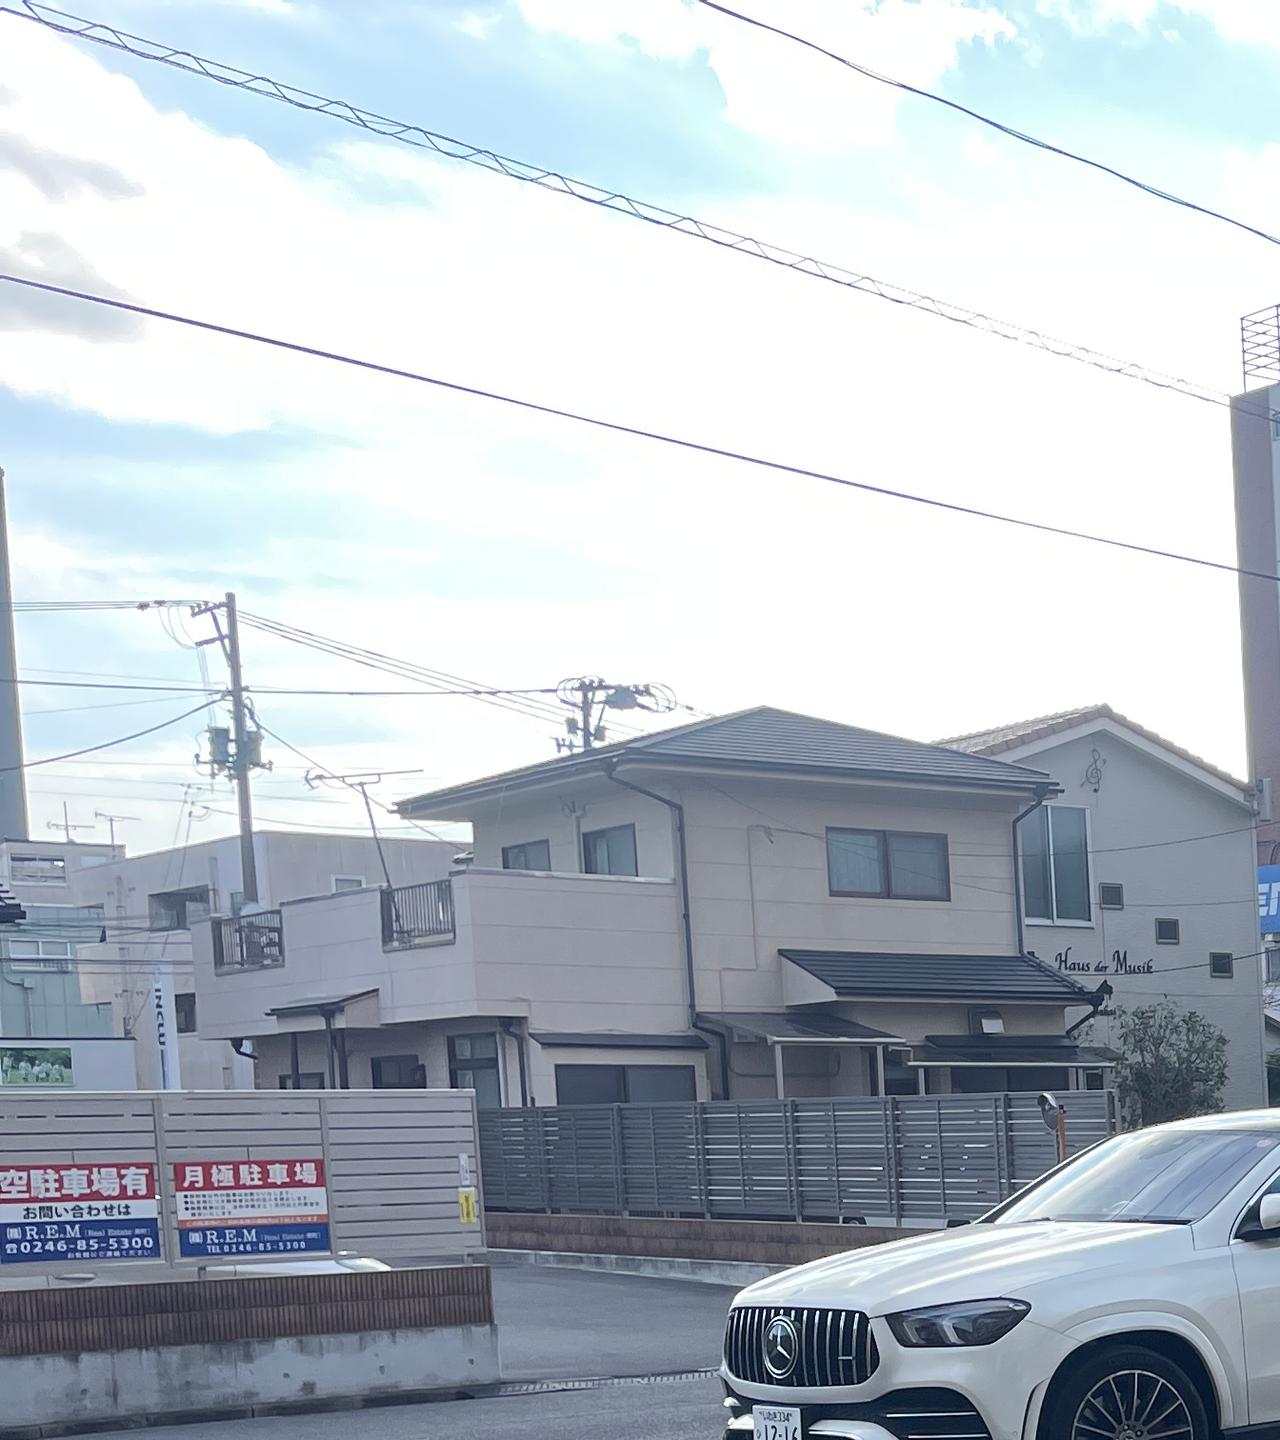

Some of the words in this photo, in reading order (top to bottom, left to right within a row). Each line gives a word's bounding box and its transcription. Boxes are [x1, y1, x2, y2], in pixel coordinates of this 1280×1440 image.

[1055, 947, 1091, 972] Haus
[1094, 961, 1109, 972] der
[1112, 950, 1153, 974] Musik
[0, 1166, 149, 1199] 空駐車場有
[183, 1162, 317, 1188] 月極駐車場
[23, 1204, 132, 1220] お問い合わせは
[25, 1224, 81, 1240] R.E.M
[205, 1229, 257, 1244] R.E.M
[20, 1237, 154, 1253] 0246-85-5300
[223, 1241, 306, 1253] 0246-85-5300
